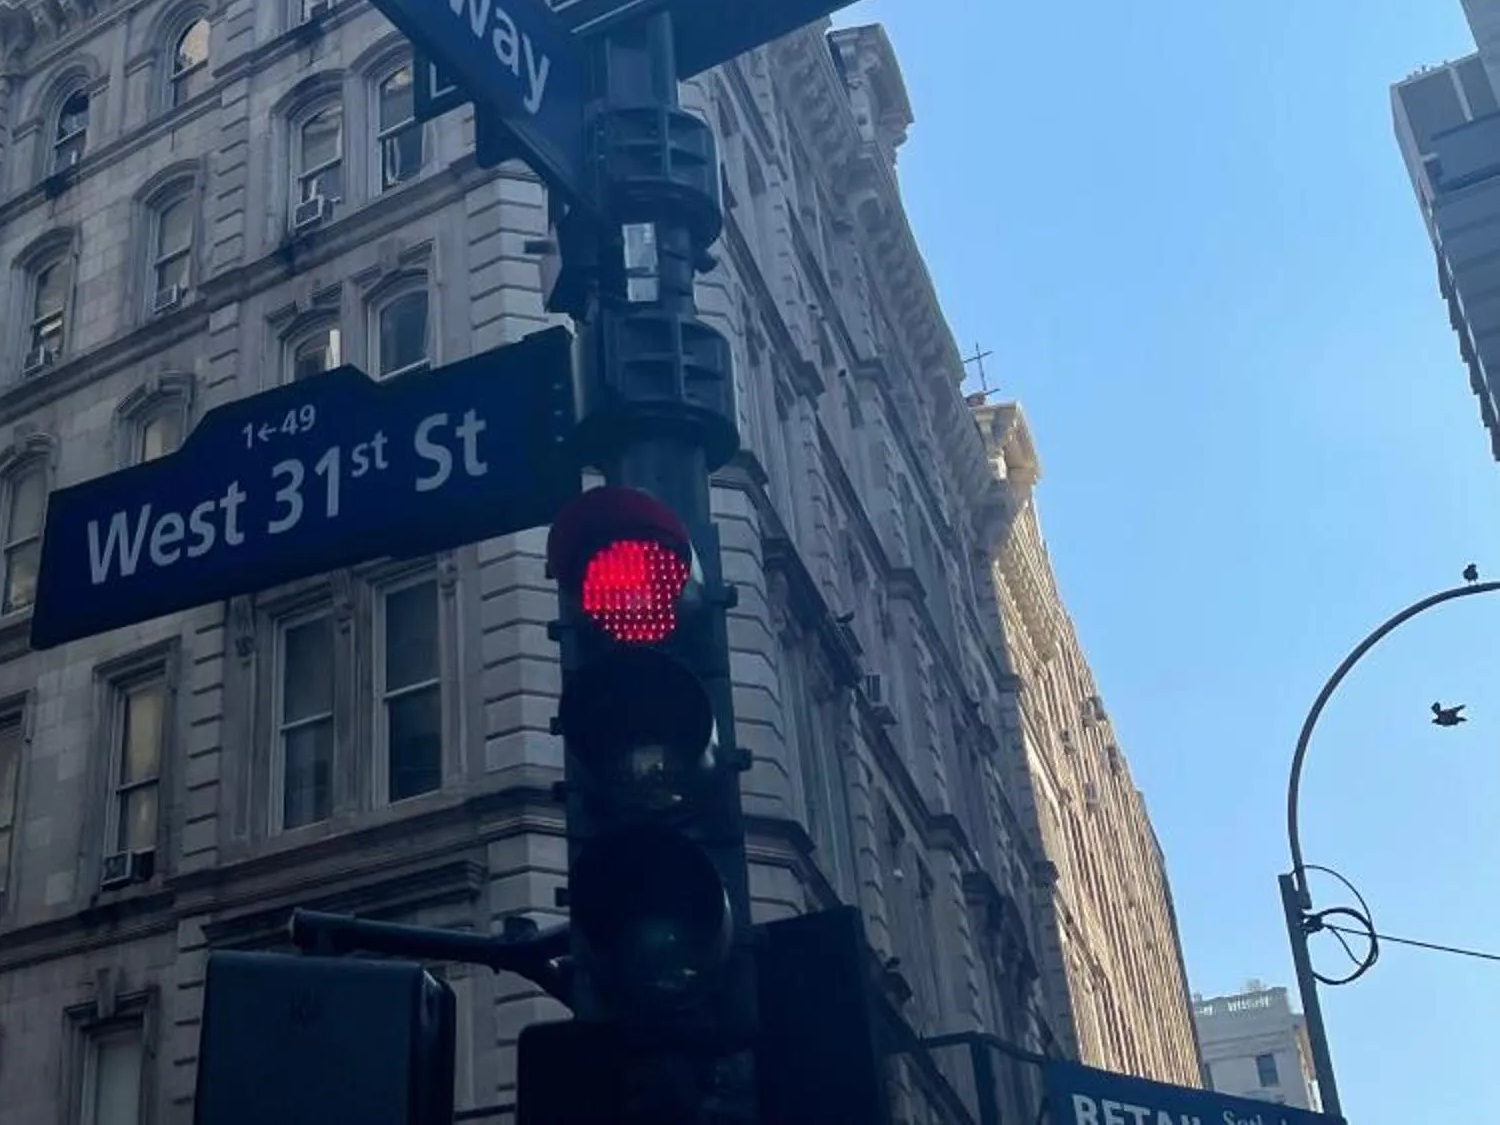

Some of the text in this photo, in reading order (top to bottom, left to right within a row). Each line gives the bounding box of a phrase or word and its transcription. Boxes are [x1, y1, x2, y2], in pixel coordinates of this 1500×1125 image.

[87, 408, 489, 585] West 31st St
